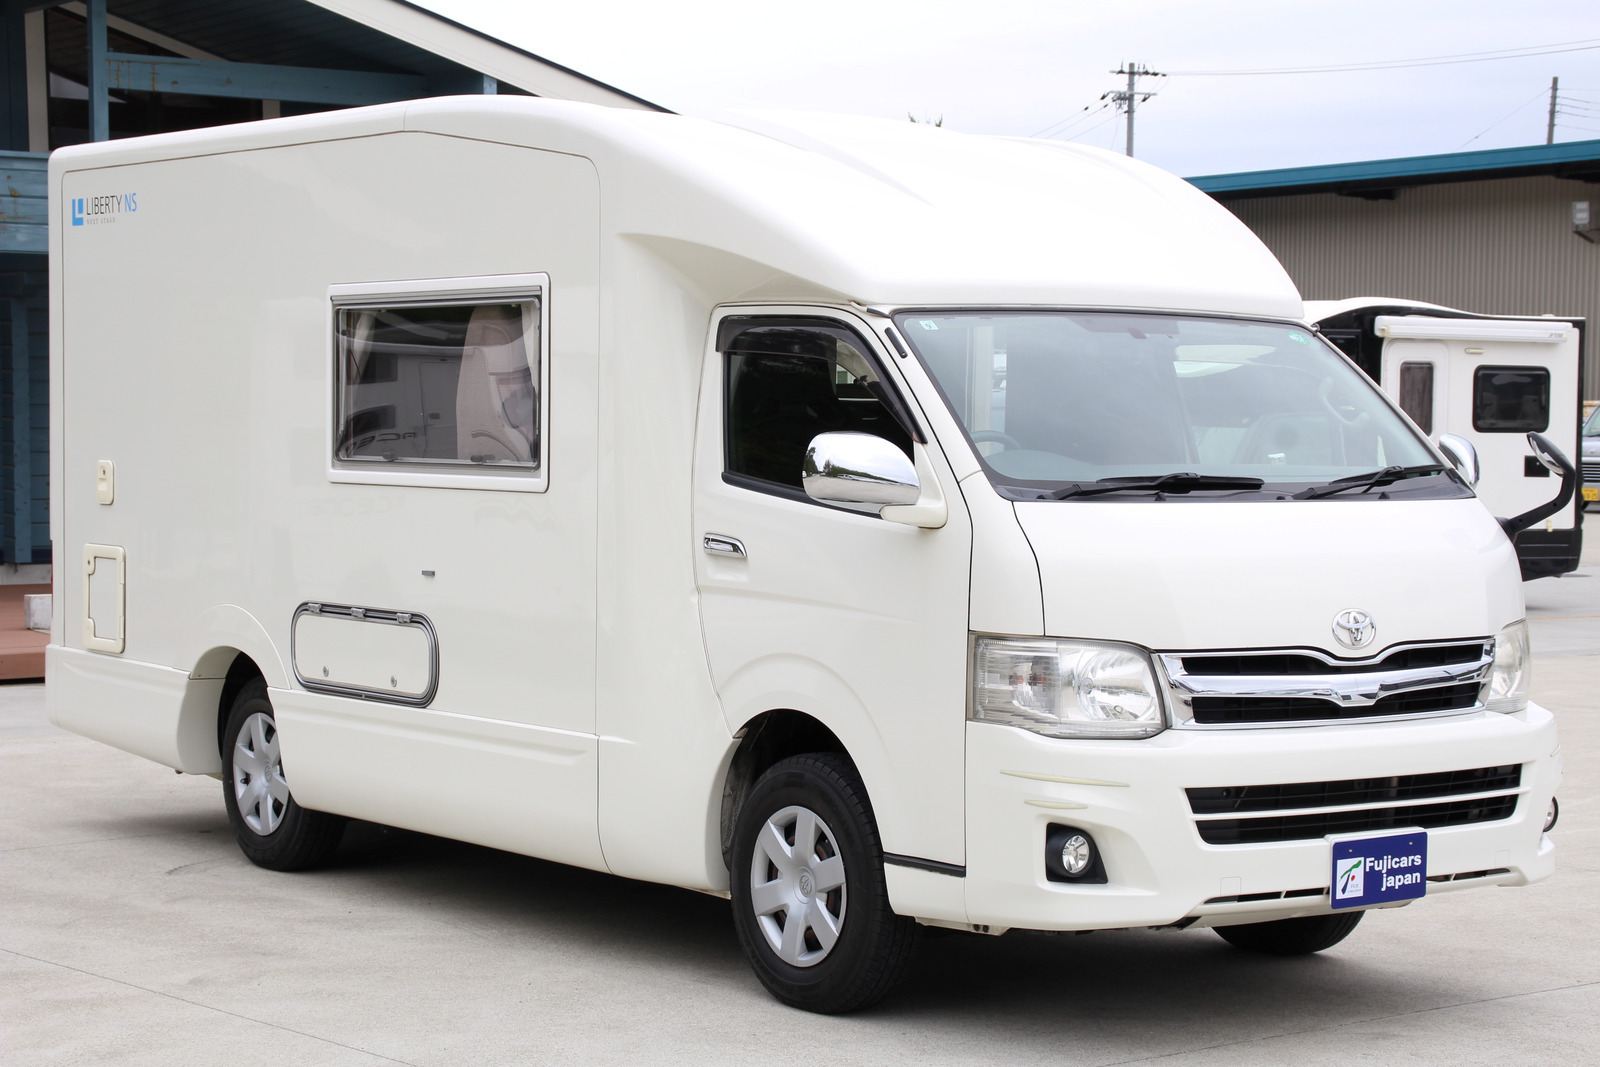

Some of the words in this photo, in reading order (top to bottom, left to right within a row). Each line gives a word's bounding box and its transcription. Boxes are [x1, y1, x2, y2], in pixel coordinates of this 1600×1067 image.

[86, 194, 122, 215] LIBERTY
[124, 193, 137, 212] NS
[1365, 855, 1421, 873] Fujicars
[1381, 873, 1420, 891] japan
